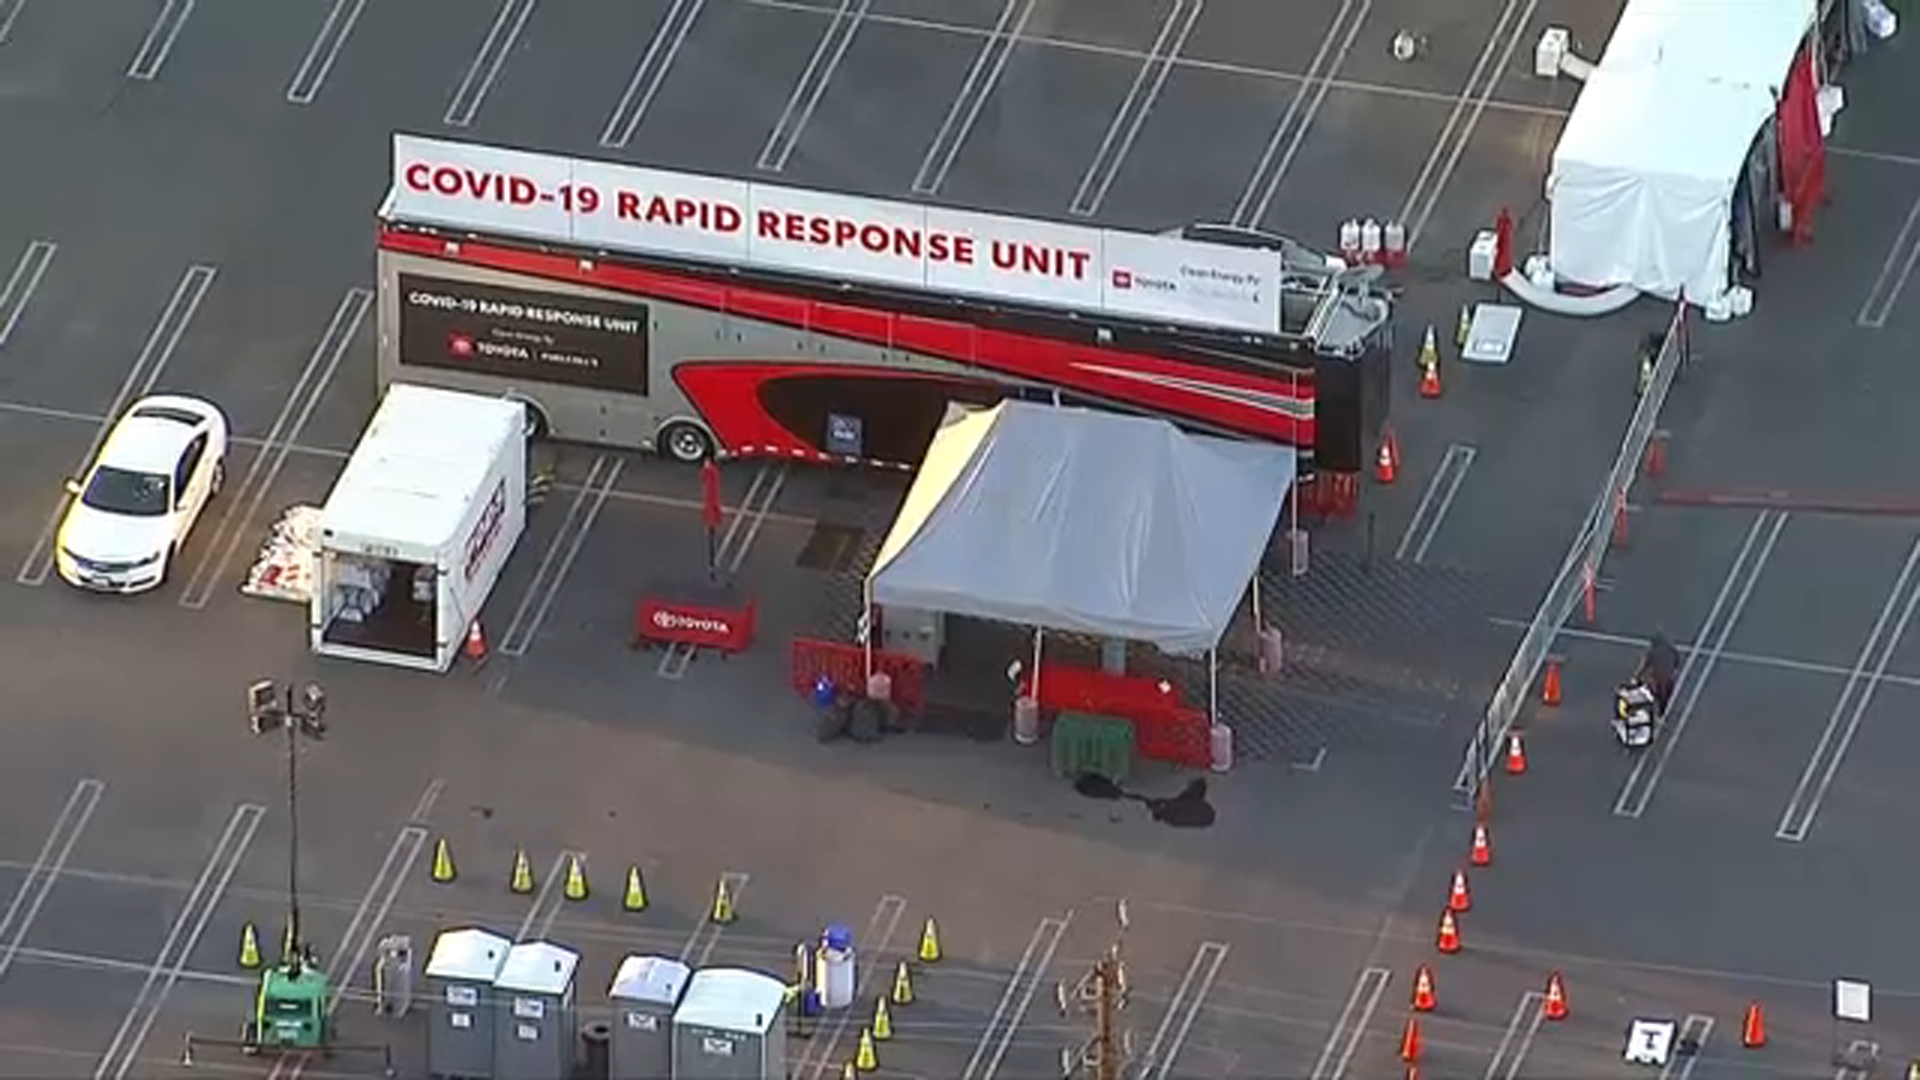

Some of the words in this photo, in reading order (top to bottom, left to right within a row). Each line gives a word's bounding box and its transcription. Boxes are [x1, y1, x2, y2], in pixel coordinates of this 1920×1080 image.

[406, 164, 600, 213] COVID-19
[618, 191, 742, 232] RAPID
[758, 211, 975, 264] RESPONSE
[991, 240, 1090, 279] UNIT
[408, 291, 478, 314] COVID-19
[479, 301, 524, 317] RAPID
[526, 305, 601, 329] RESPONSE
[603, 318, 640, 334] UNIT
[476, 341, 529, 360] TOYOTA
[676, 614, 730, 634] TOYOTA
